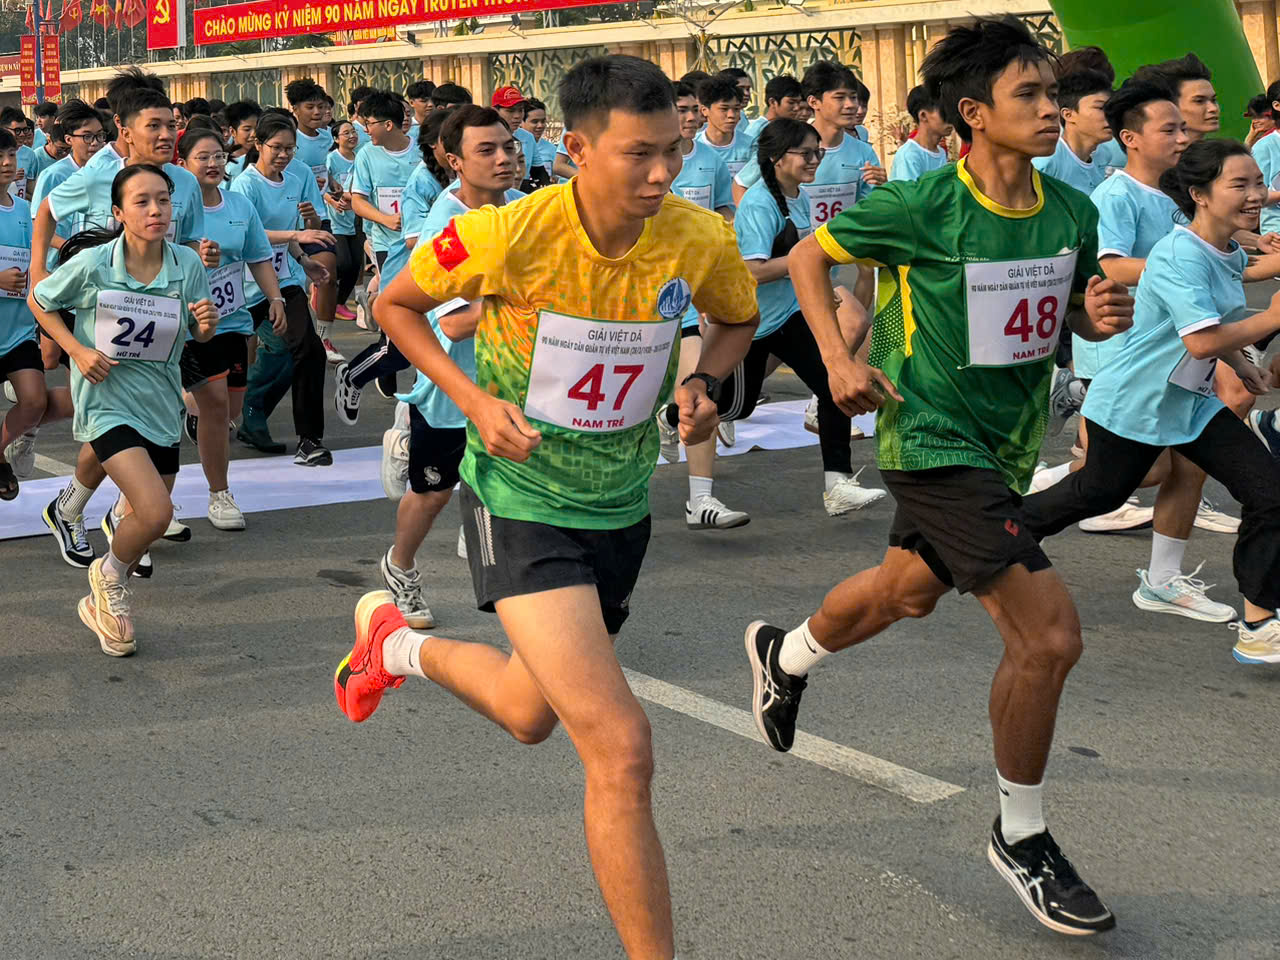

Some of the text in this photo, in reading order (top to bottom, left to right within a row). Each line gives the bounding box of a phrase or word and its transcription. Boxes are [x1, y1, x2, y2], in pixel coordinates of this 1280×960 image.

[204, 13, 235, 37] CHÀO
[238, 10, 272, 32] MỪNG
[275, 4, 289, 29] KỶ
[293, 4, 322, 32] NIỆM
[325, 7, 340, 23] 90
[815, 200, 843, 222] 36
[211, 281, 235, 309] 39
[111, 317, 156, 348] 24
[1004, 295, 1058, 343] 48
[588, 328, 606, 341] GIẢI
[609, 329, 629, 344] VIỆT
[1013, 349, 1035, 360] NAM
[567, 363, 645, 411] 47
[572, 418, 603, 428] NAM
